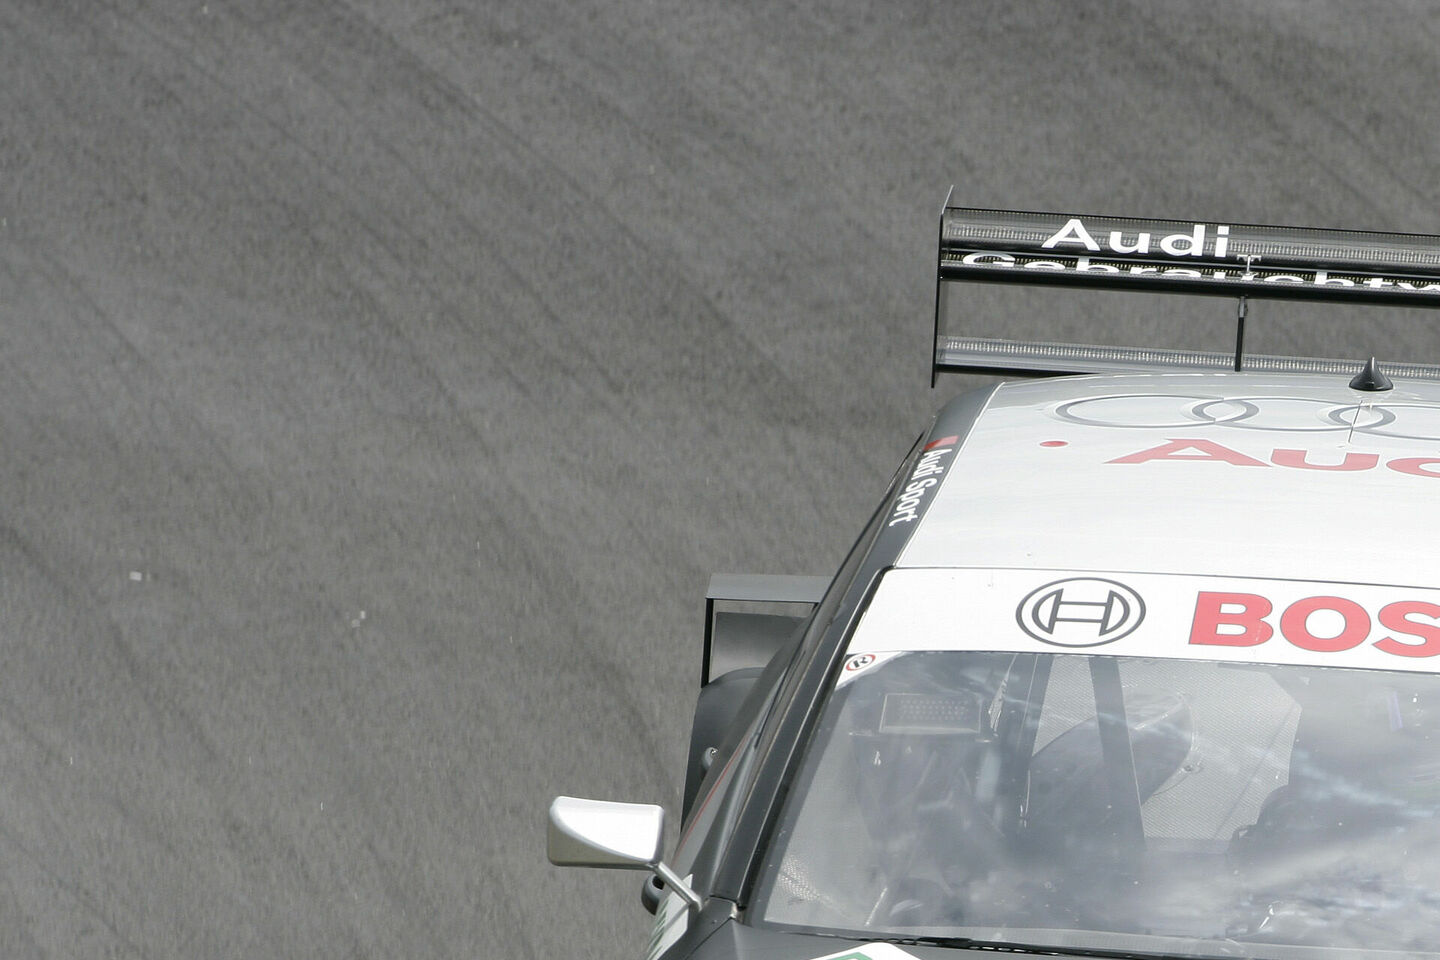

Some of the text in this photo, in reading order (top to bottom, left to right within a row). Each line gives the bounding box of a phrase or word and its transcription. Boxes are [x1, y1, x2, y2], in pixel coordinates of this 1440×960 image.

[1041, 218, 1230, 258] Audi
[889, 448, 952, 526] Audi Sport
